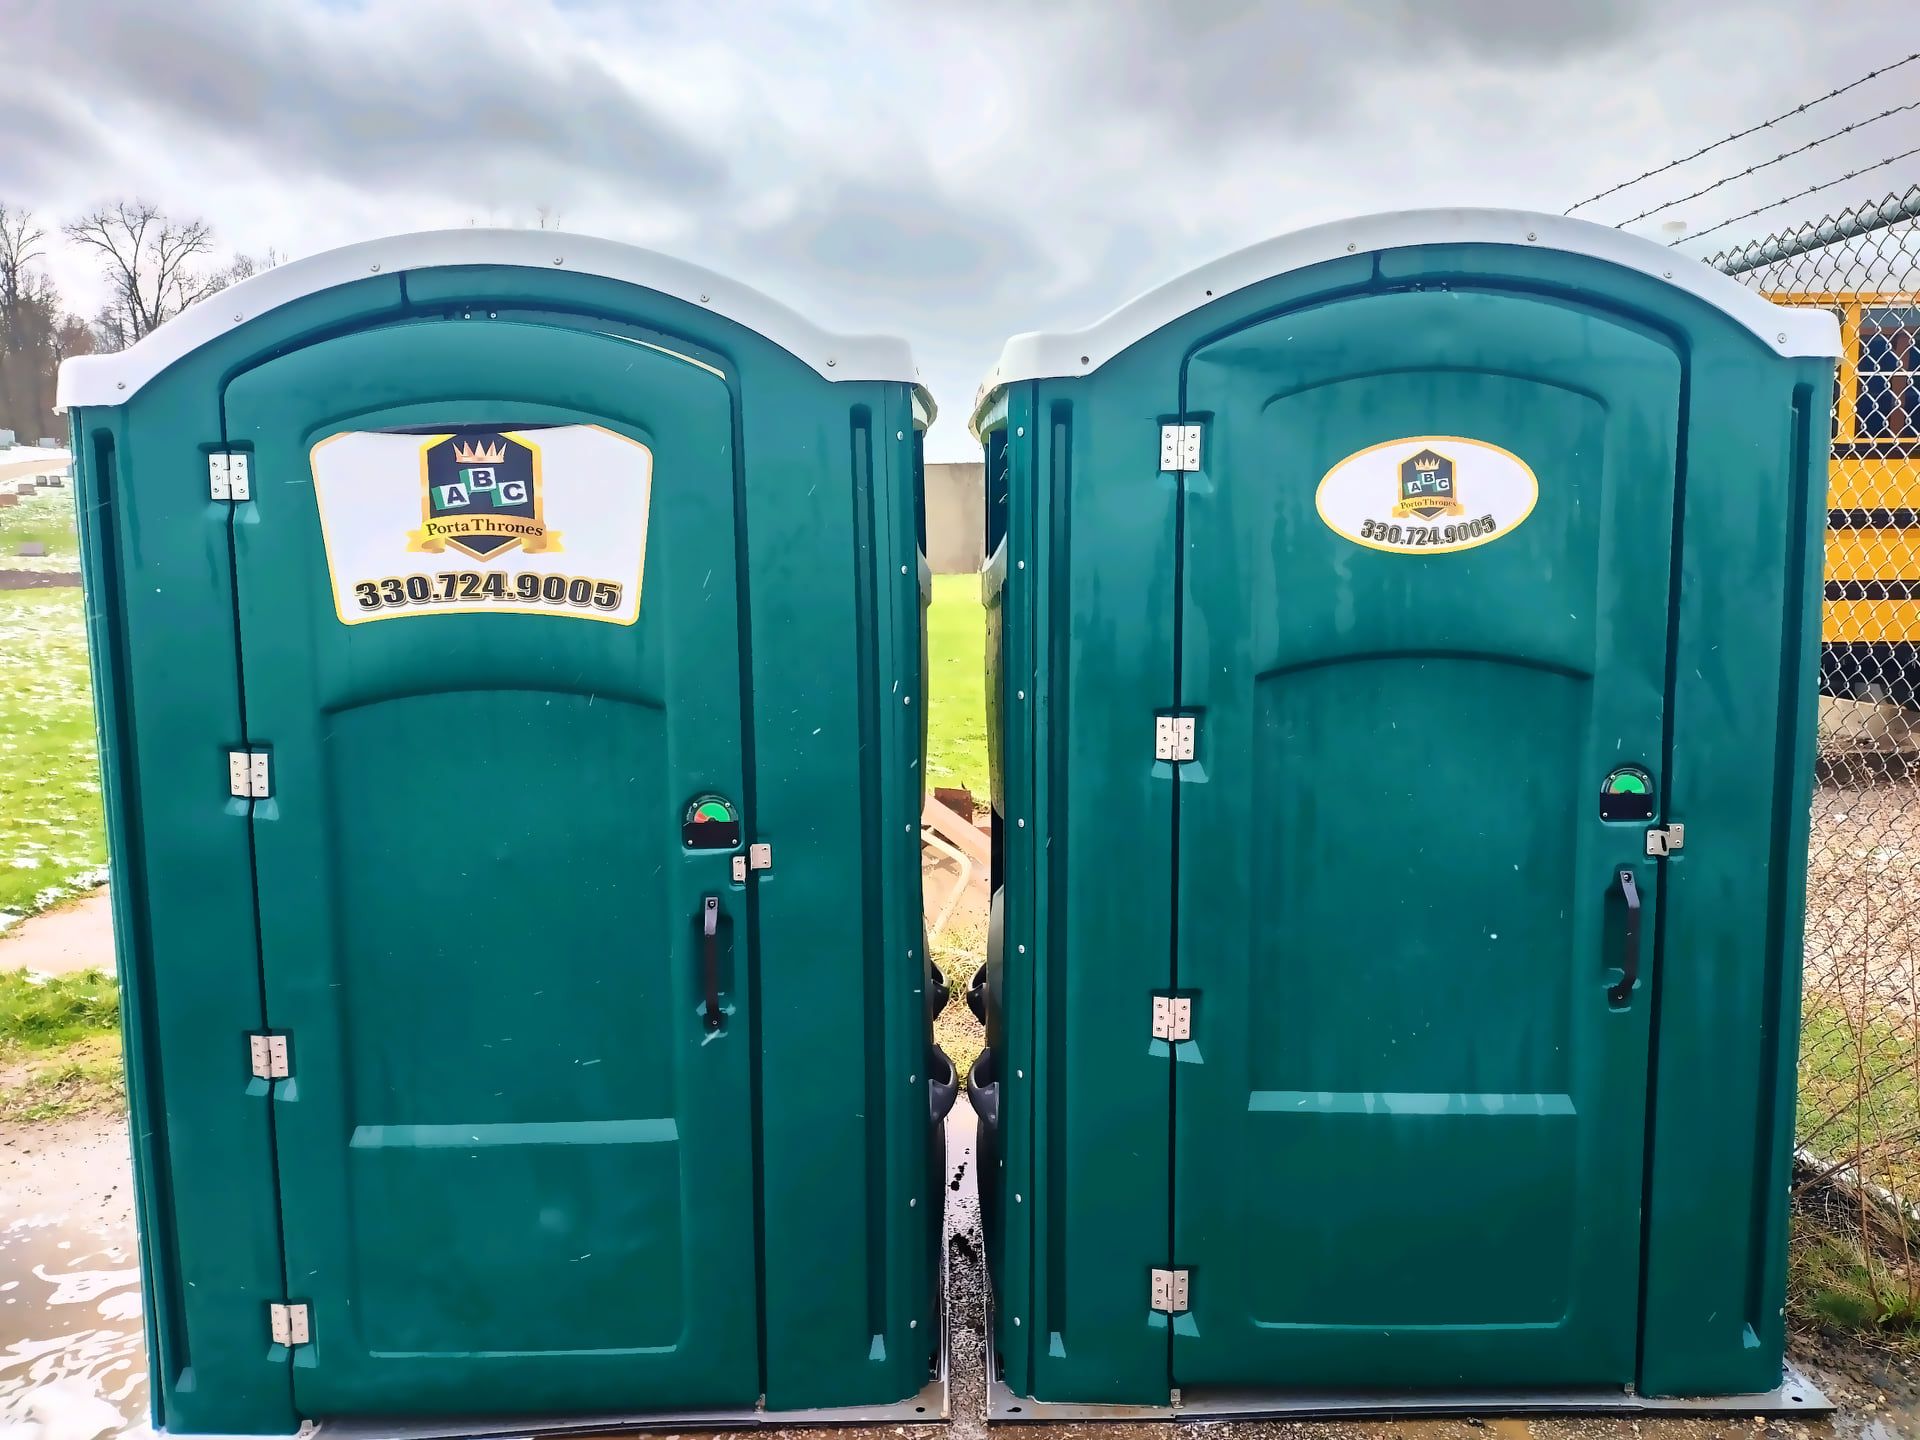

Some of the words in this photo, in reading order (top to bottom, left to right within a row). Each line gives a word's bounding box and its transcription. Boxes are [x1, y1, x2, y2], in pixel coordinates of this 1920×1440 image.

[426, 519, 471, 537] Porta
[471, 518, 543, 537] Thrones
[1360, 514, 1497, 546] 330.724.9005
[355, 573, 622, 610] 330.724.9005
